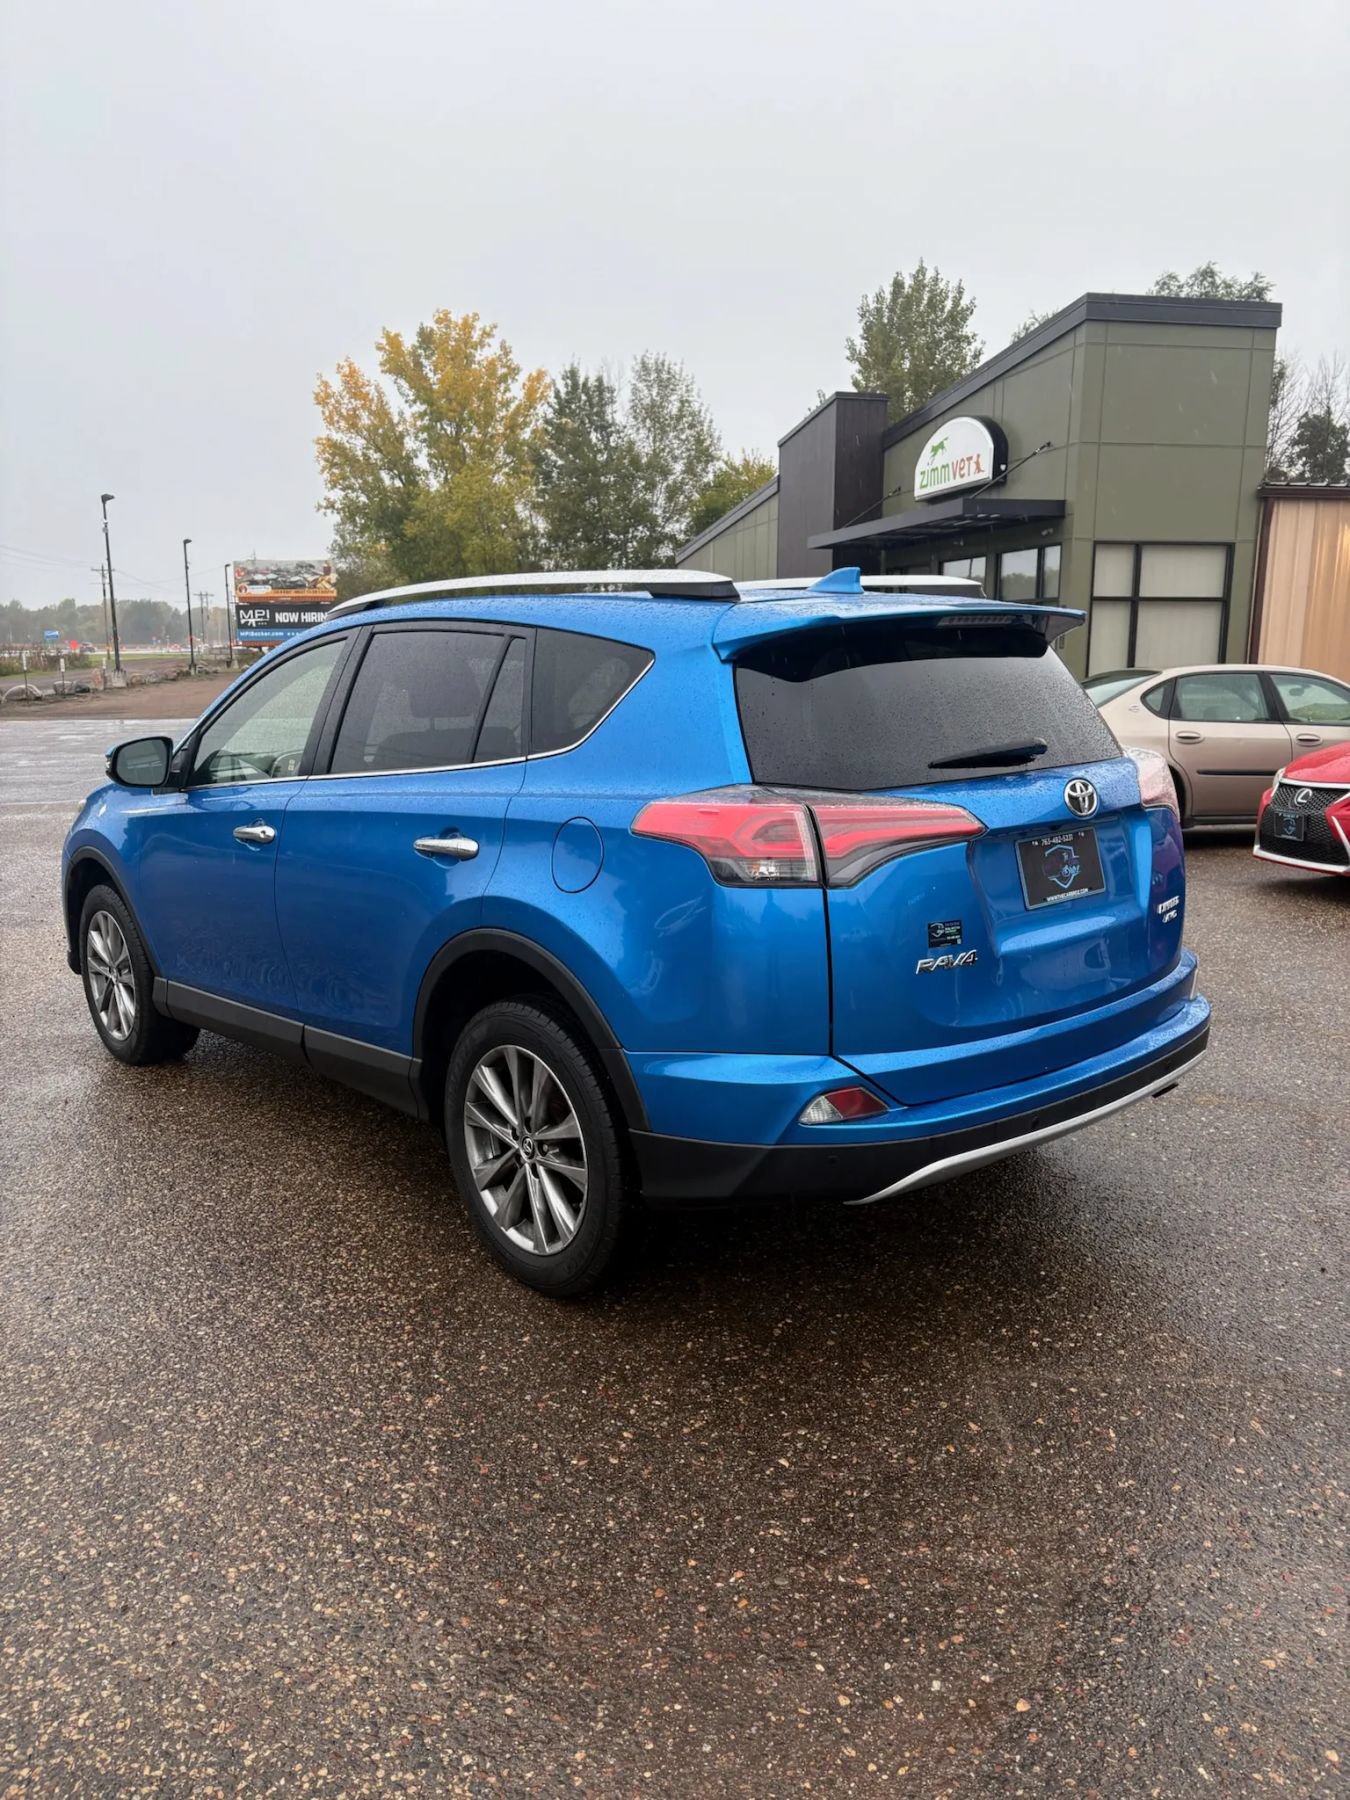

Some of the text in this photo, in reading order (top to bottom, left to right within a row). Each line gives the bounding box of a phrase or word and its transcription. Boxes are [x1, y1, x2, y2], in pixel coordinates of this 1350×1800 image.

[239, 609, 270, 620] MPI
[275, 611, 299, 623] NOW
[915, 949, 977, 975] RAV4
